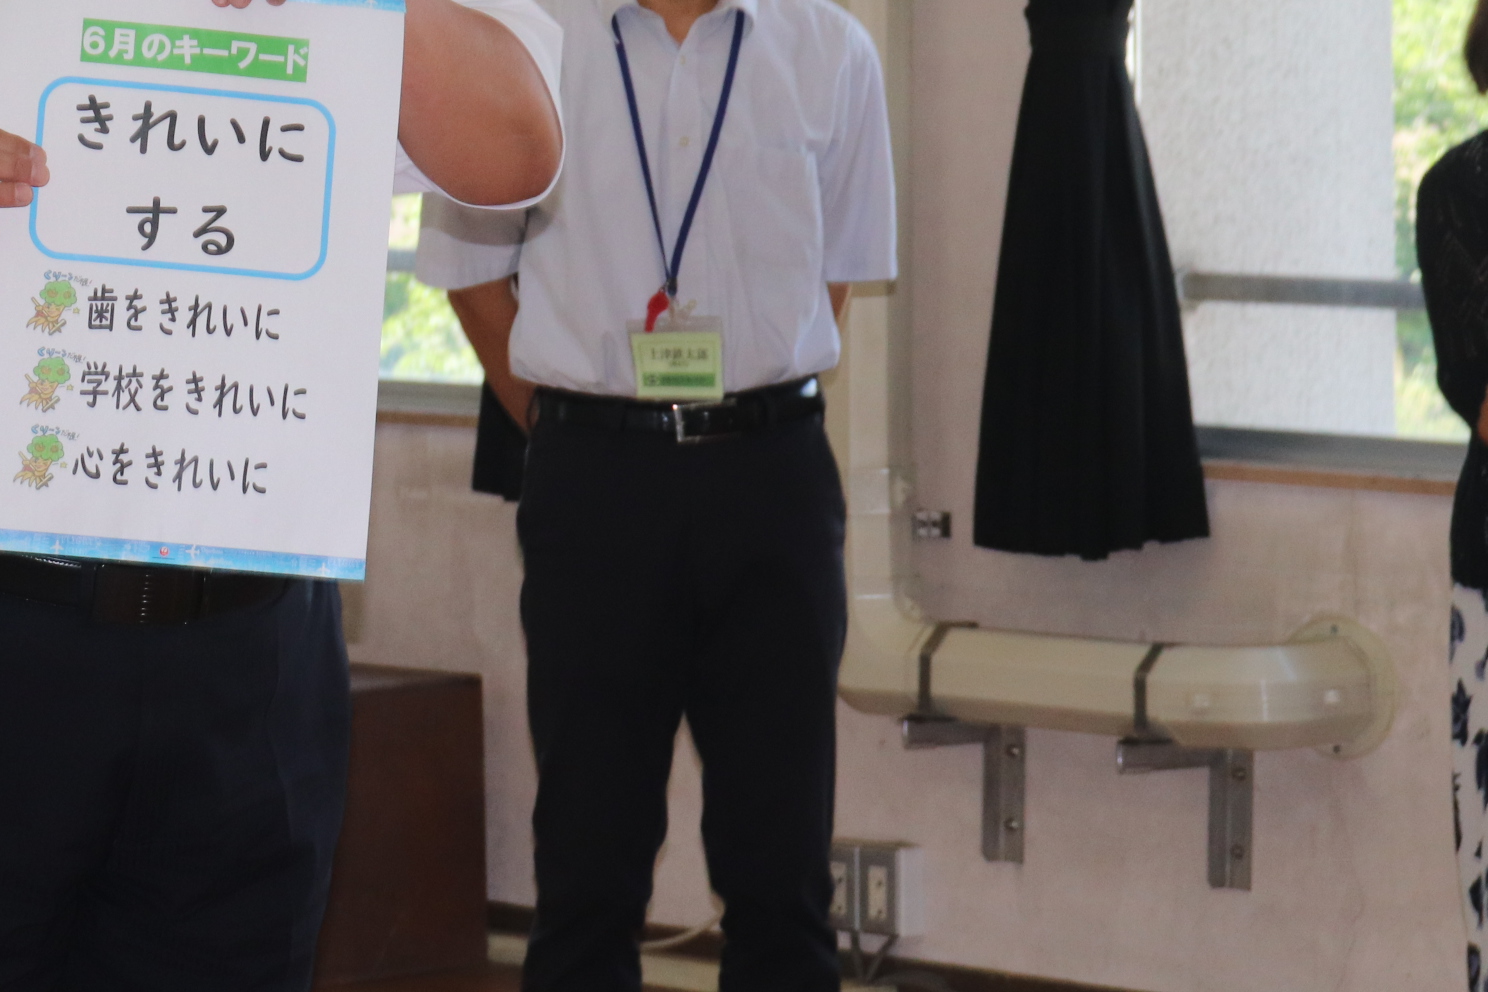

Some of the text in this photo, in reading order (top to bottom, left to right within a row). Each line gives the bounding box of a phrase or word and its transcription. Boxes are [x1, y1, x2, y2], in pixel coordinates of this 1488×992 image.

[82, 25, 309, 75] 6月のキーワード
[76, 94, 305, 162] きれいに
[125, 196, 235, 256] する
[87, 283, 281, 340] 歯をきれいに
[79, 361, 307, 420] 学校をきれいに
[72, 442, 268, 495] 心をきれいに
